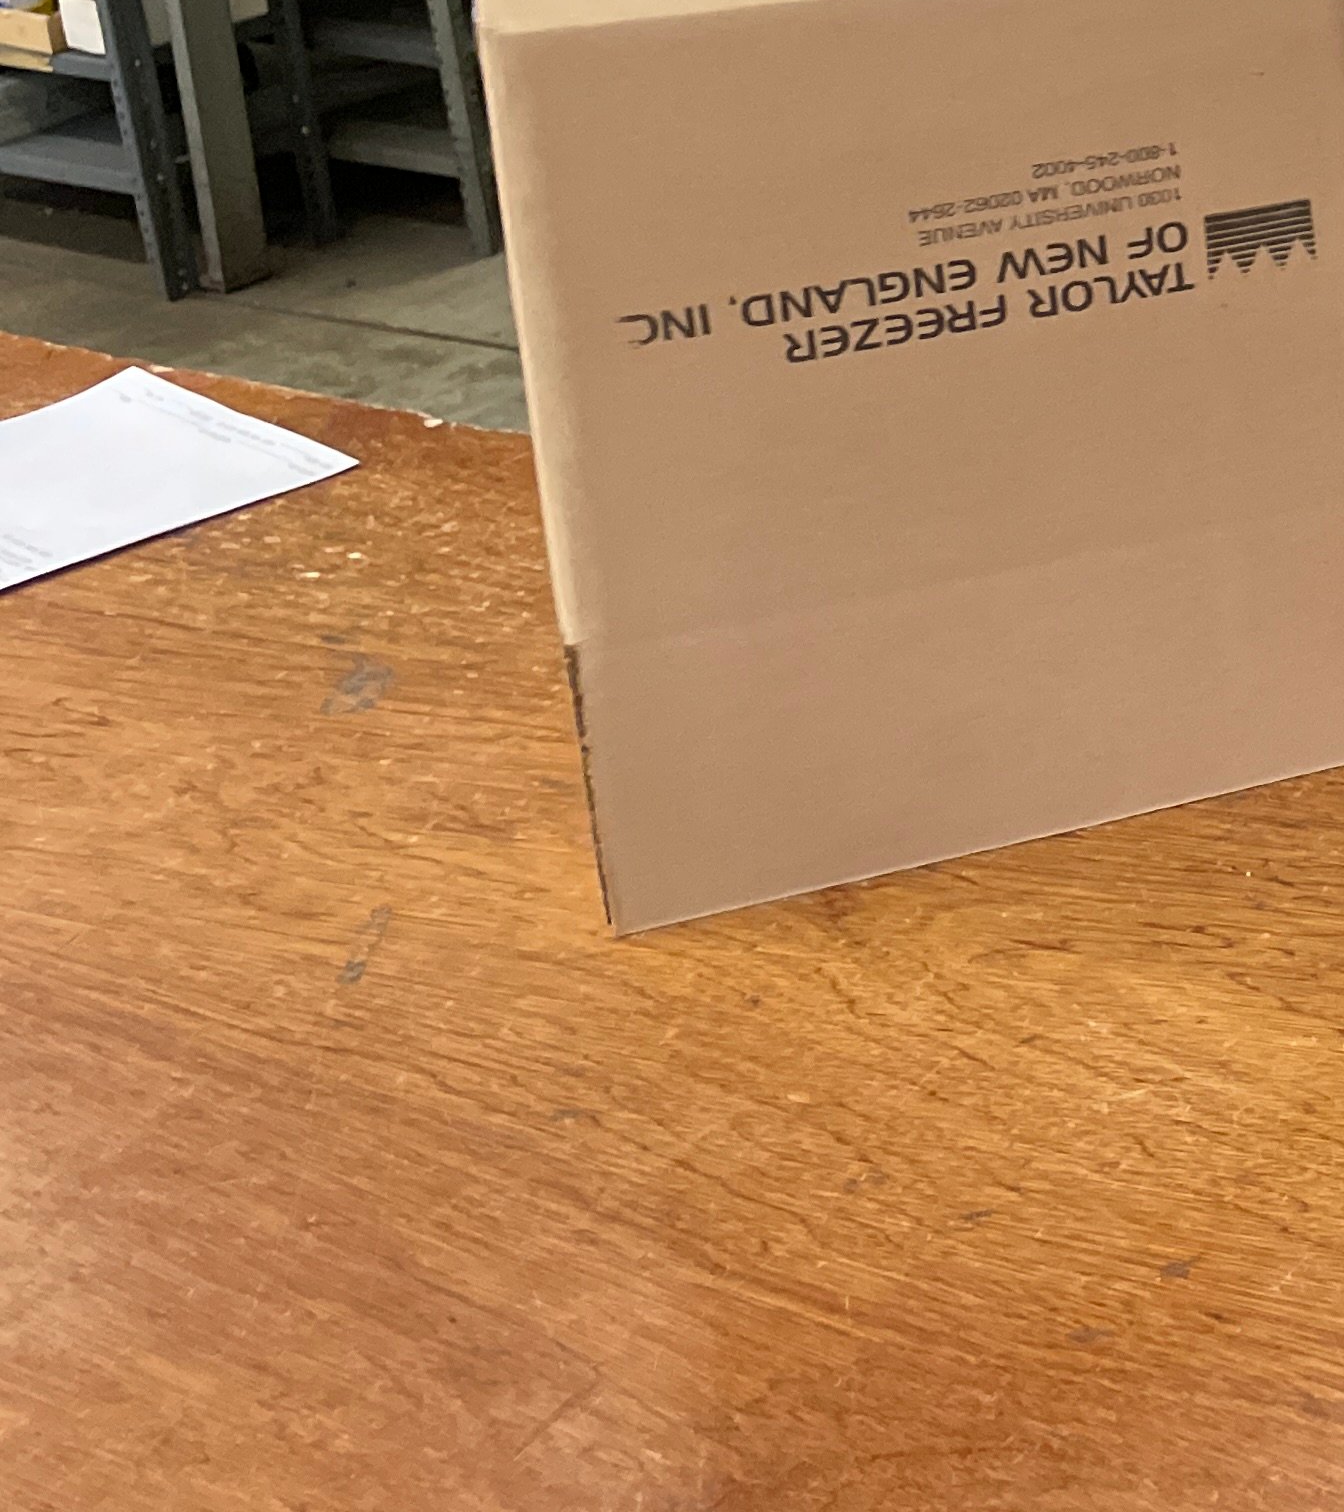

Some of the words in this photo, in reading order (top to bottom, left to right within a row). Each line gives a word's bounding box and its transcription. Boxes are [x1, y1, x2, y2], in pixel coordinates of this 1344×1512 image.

[908, 190, 1022, 224] 02062-2644
[1026, 185, 1060, 202] MA
[1138, 188, 1183, 208] 1030
[919, 217, 1004, 248] AVENUE
[1010, 196, 1134, 232] UNIVERSITY
[1126, 221, 1188, 259] OF
[997, 235, 1107, 284] NEW
[728, 259, 977, 329] ENGLAND,
[1026, 263, 1194, 319] TAYLOR
[615, 304, 712, 348] INC
[782, 295, 1008, 364] FREEZER
